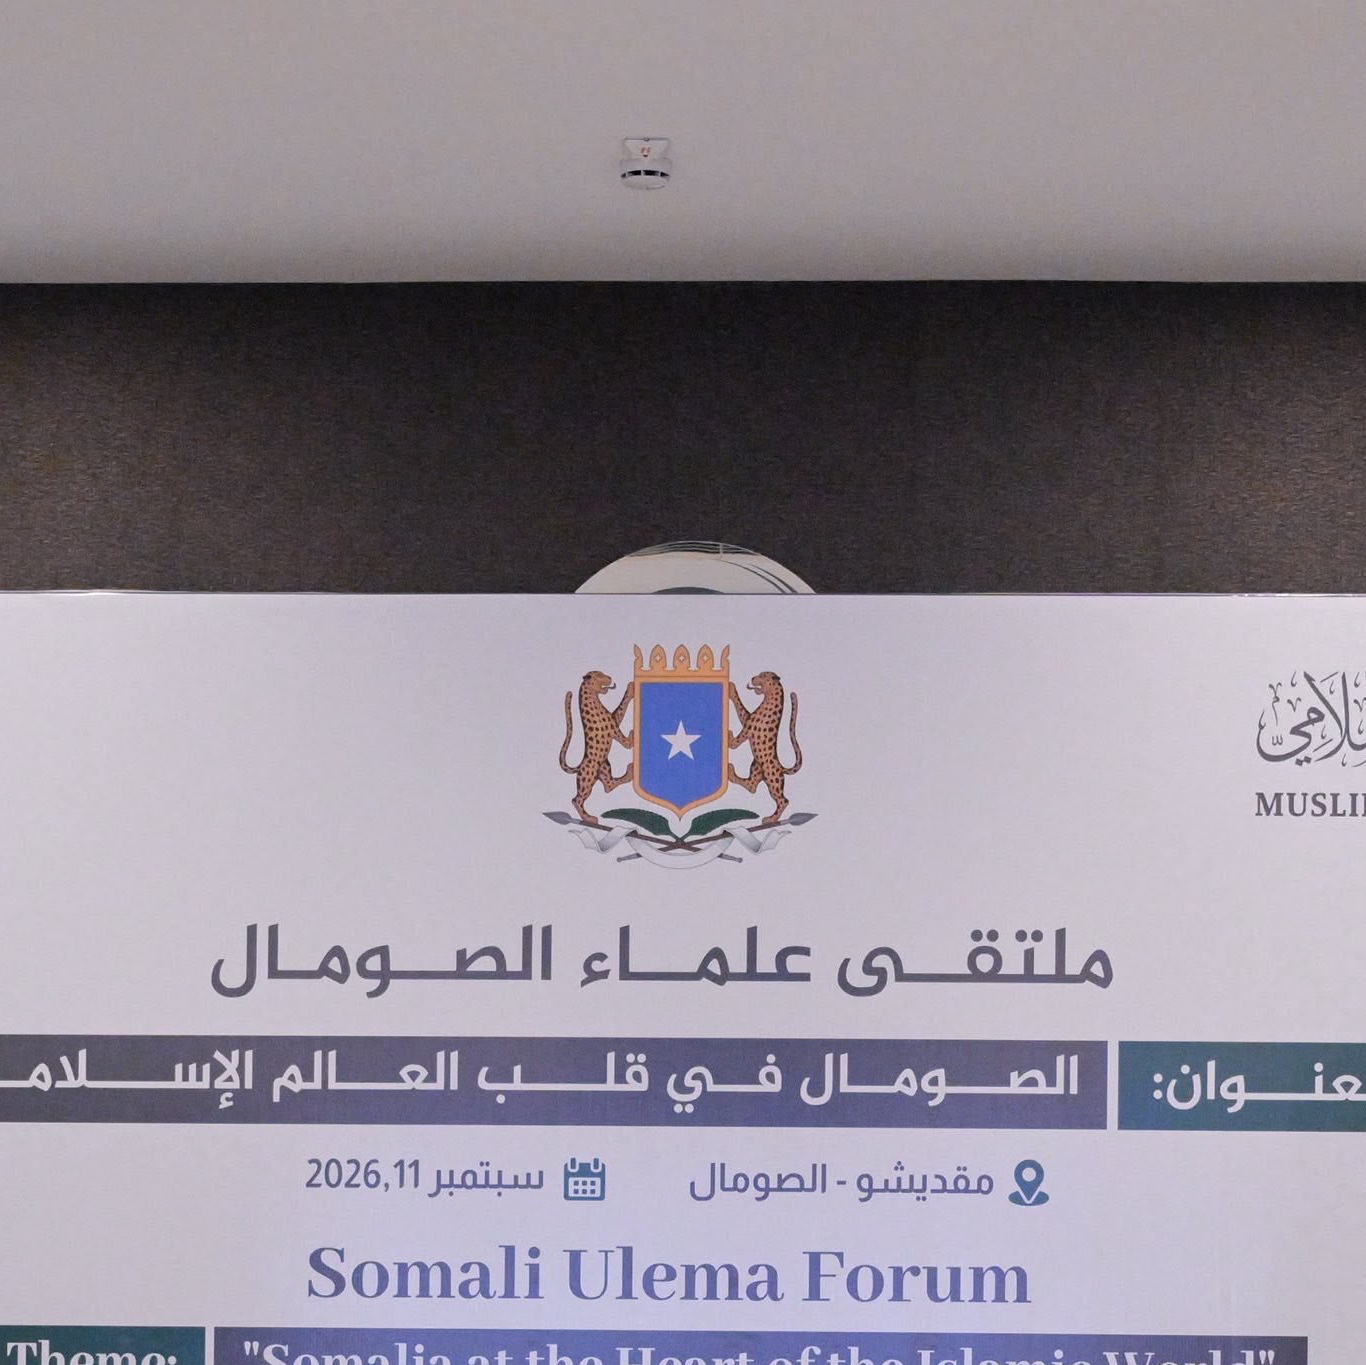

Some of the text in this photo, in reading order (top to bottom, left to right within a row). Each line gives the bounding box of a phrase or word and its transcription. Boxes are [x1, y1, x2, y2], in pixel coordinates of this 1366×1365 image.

[210, 922, 1114, 999] ملتقى علماء الصومال
[272, 1049, 459, 1103] العالم
[477, 1050, 650, 1105] قلب
[666, 1053, 783, 1114] في
[799, 1052, 1079, 1107] الصومال
[426, 1160, 544, 1199] سبتمبر
[689, 1162, 827, 1202] الصومال
[856, 1160, 994, 1203] مقديشو
[307, 1244, 1032, 1304] Somali Ulema Forum
